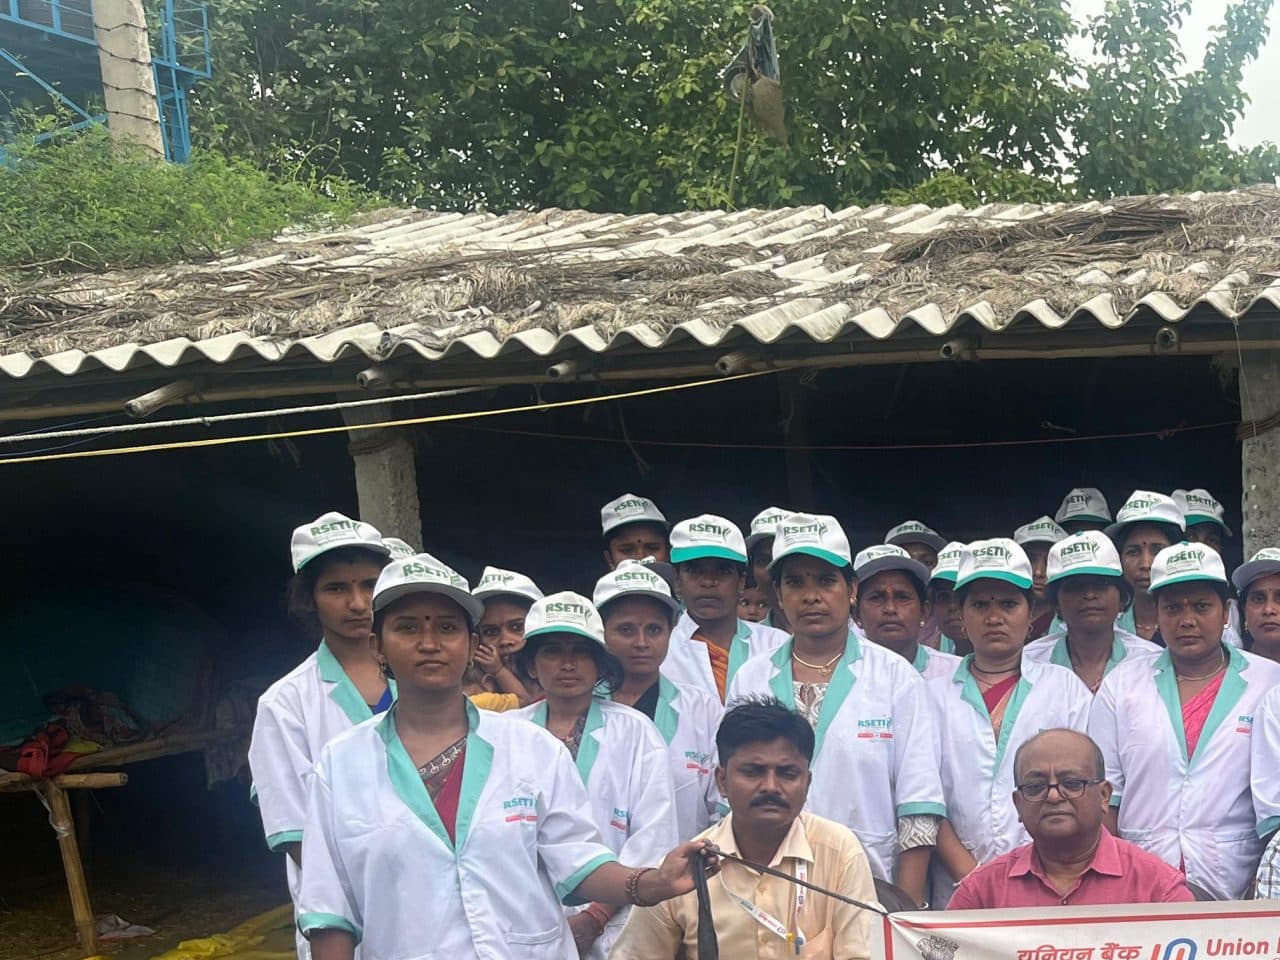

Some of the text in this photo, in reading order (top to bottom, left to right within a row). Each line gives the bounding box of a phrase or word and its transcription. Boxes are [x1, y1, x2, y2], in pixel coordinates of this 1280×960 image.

[614, 499, 642, 512] RSETI
[754, 514, 782, 526] RSETI
[310, 520, 352, 536] RSETI
[688, 523, 722, 534] RSETI
[783, 523, 818, 535] RSETI
[973, 546, 1004, 557] RSETI
[1060, 541, 1090, 557] RSETI
[1166, 550, 1197, 565] RSETI
[403, 562, 448, 578] RSETI
[614, 572, 650, 582] RSETI
[545, 603, 584, 613] RSETI
[858, 720, 885, 728] RSETI
[1100, 943, 1142, 960] बैंक
[1206, 938, 1269, 956] Union
